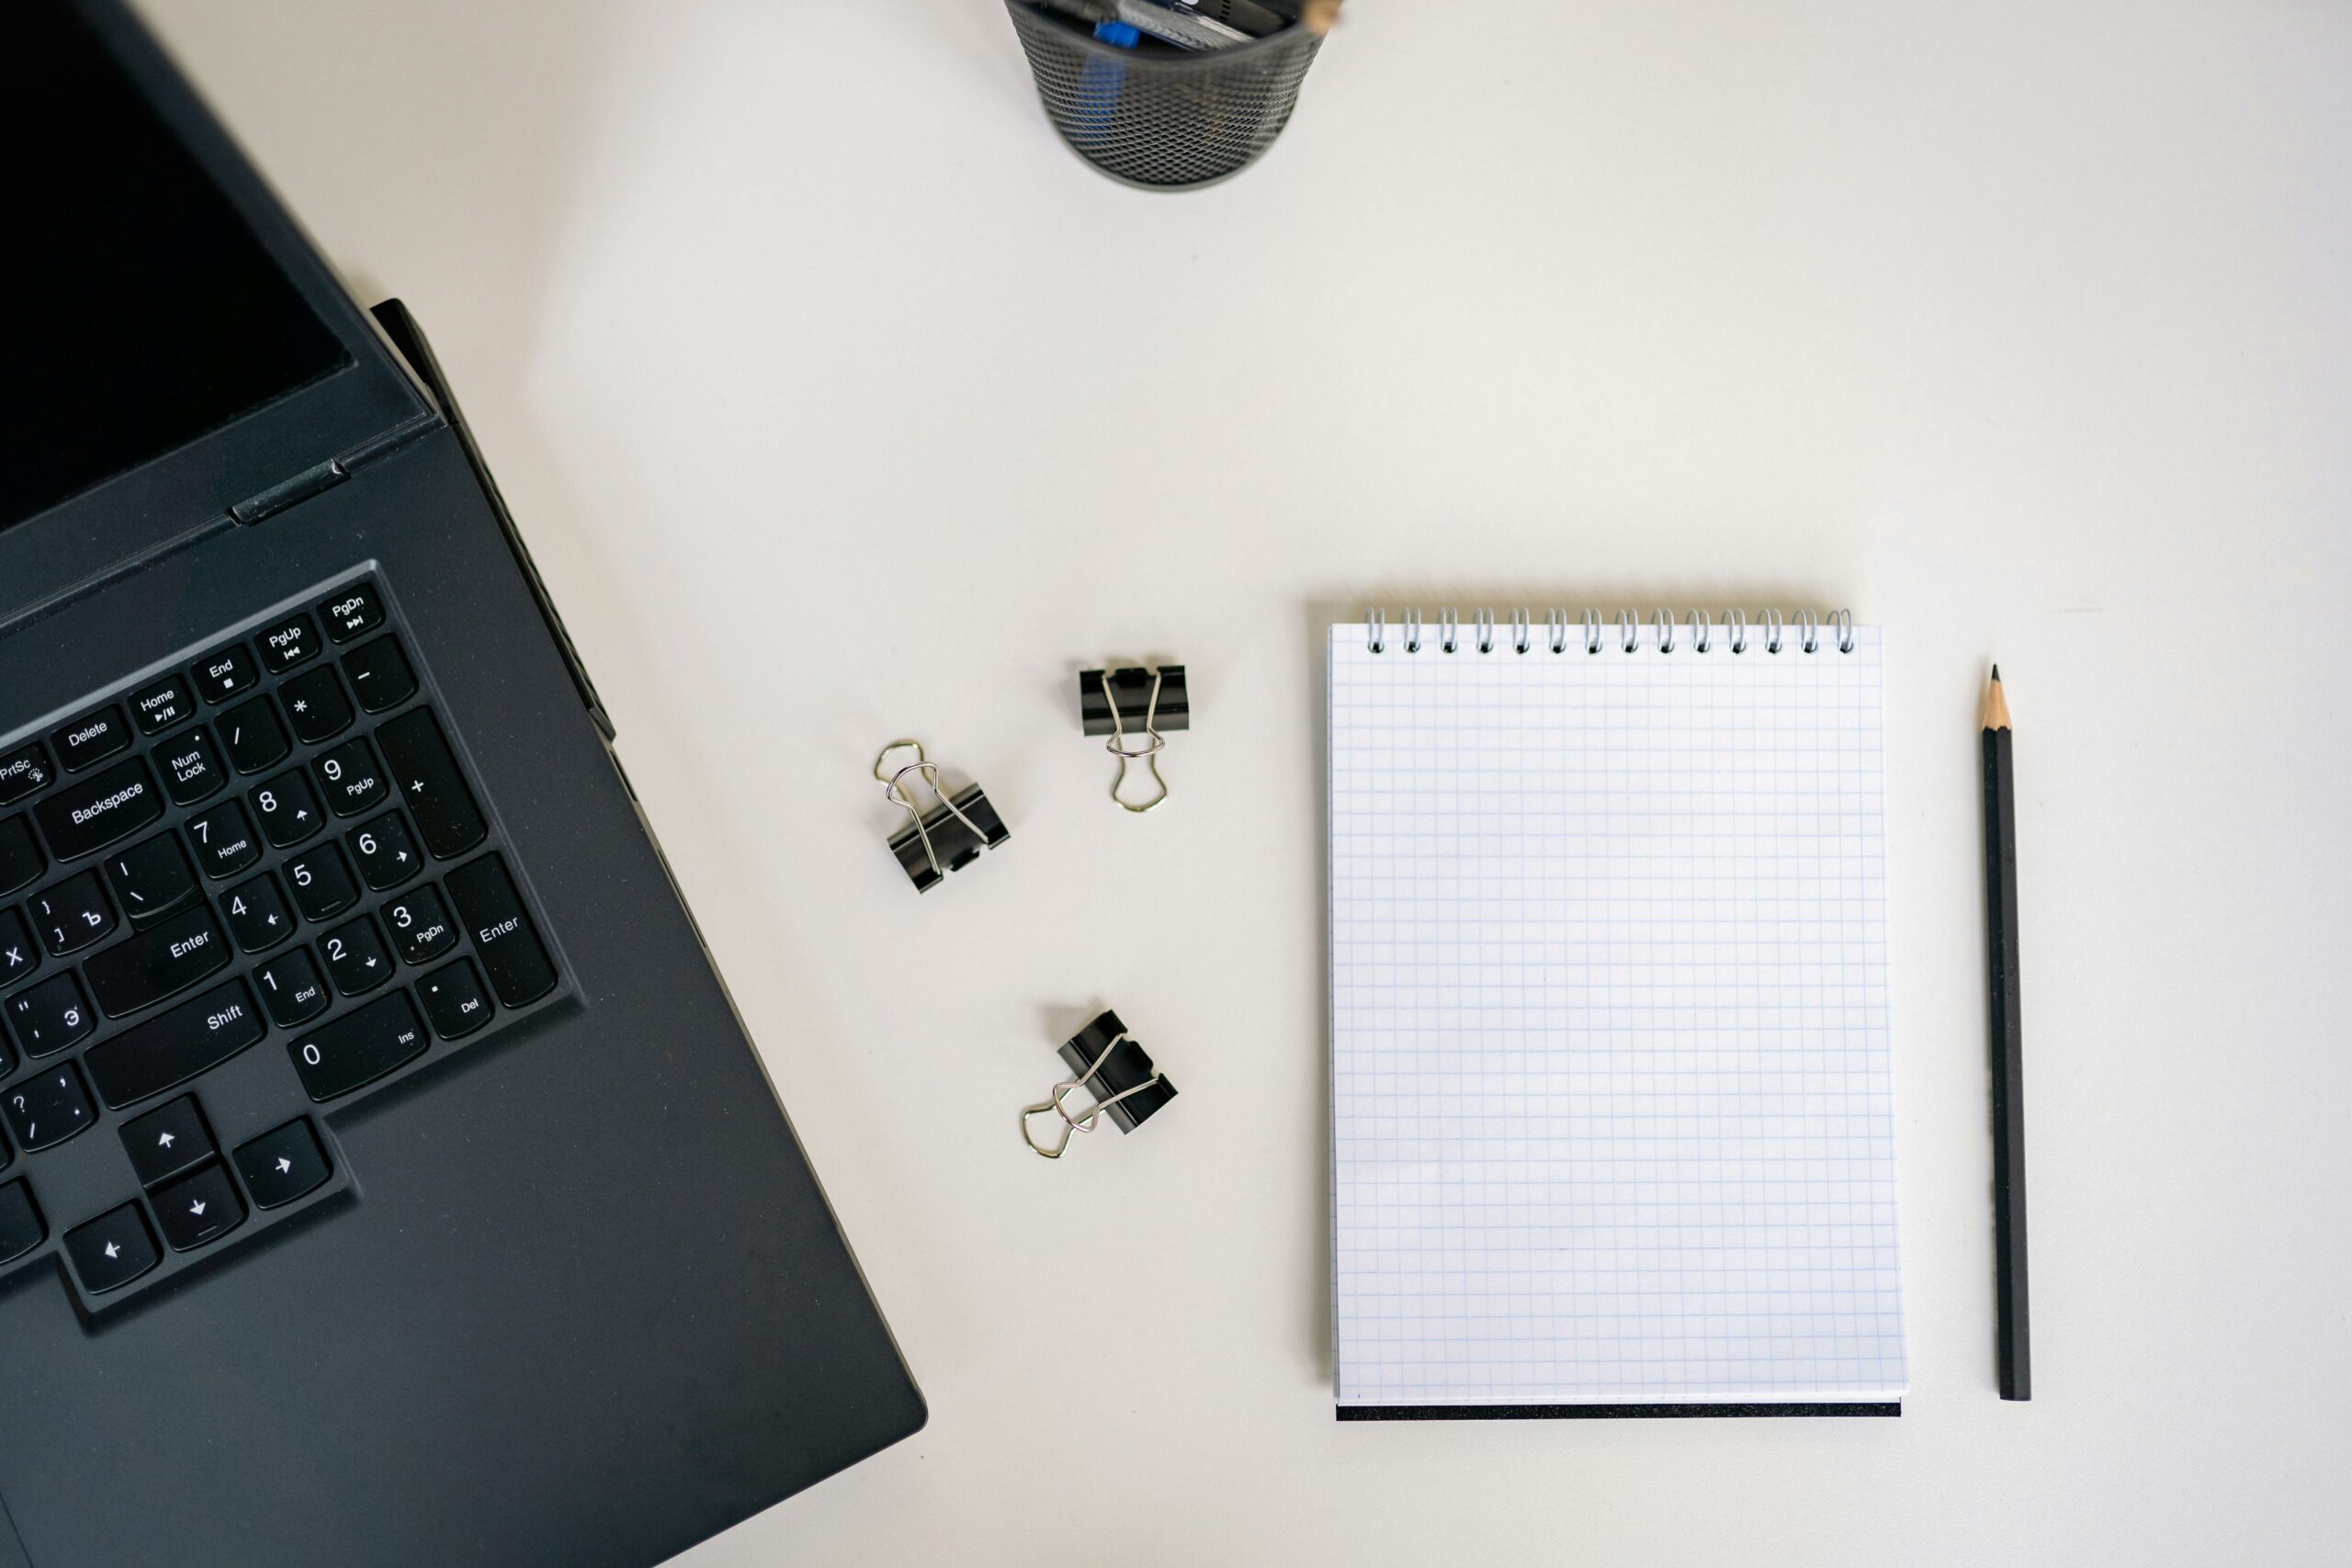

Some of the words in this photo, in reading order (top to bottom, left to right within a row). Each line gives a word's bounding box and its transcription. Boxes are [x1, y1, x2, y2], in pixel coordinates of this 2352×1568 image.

[332, 596, 365, 617] PgDn
[268, 626, 301, 648] PgUp
[209, 660, 234, 679] End
[140, 690, 175, 712] Home
[68, 722, 107, 747] Delete
[0, 759, 31, 780] PrtSc
[171, 750, 201, 770] Num
[323, 759, 342, 781] 9
[176, 762, 207, 783] Lock
[346, 777, 375, 796] PgUp
[71, 783, 143, 825] Backspace
[259, 791, 277, 813] 8
[193, 820, 208, 844] 7
[217, 840, 247, 859] Home
[358, 833, 377, 855] 6
[293, 863, 311, 886] 5
[232, 896, 247, 916] 4
[393, 906, 412, 928] 3
[416, 924, 445, 943] PgDn
[479, 917, 518, 943] Enter
[170, 931, 209, 958] Enter
[327, 938, 347, 962] 2
[263, 971, 277, 991] 1
[295, 986, 316, 1003] End
[460, 998, 480, 1013] Del
[207, 1005, 243, 1030] Shift
[398, 1030, 414, 1044] Ins
